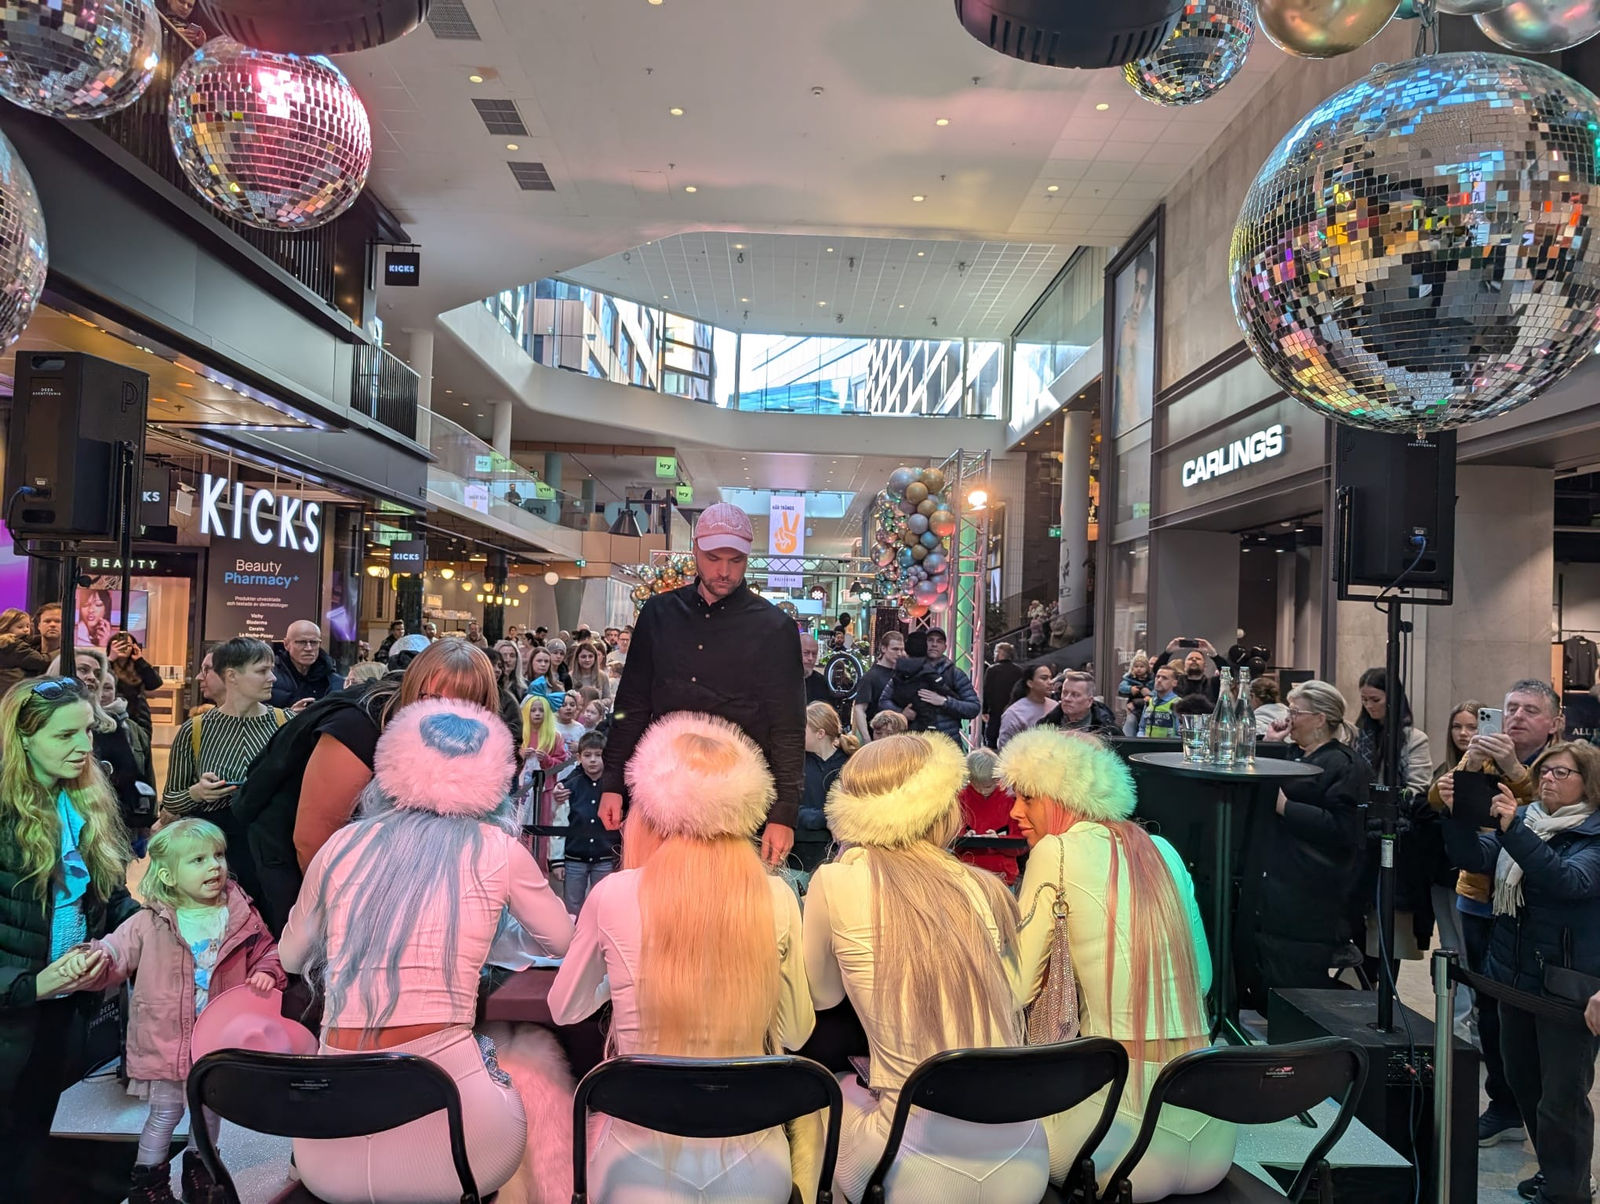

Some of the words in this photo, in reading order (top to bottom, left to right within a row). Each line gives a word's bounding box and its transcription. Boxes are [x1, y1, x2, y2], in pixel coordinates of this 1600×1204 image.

[389, 264, 415, 273] KICKS
[1182, 423, 1285, 488] CARLINGS
[200, 473, 320, 553] KICKS
[393, 553, 420, 561] KICKS
[236, 559, 282, 576] Beauty
